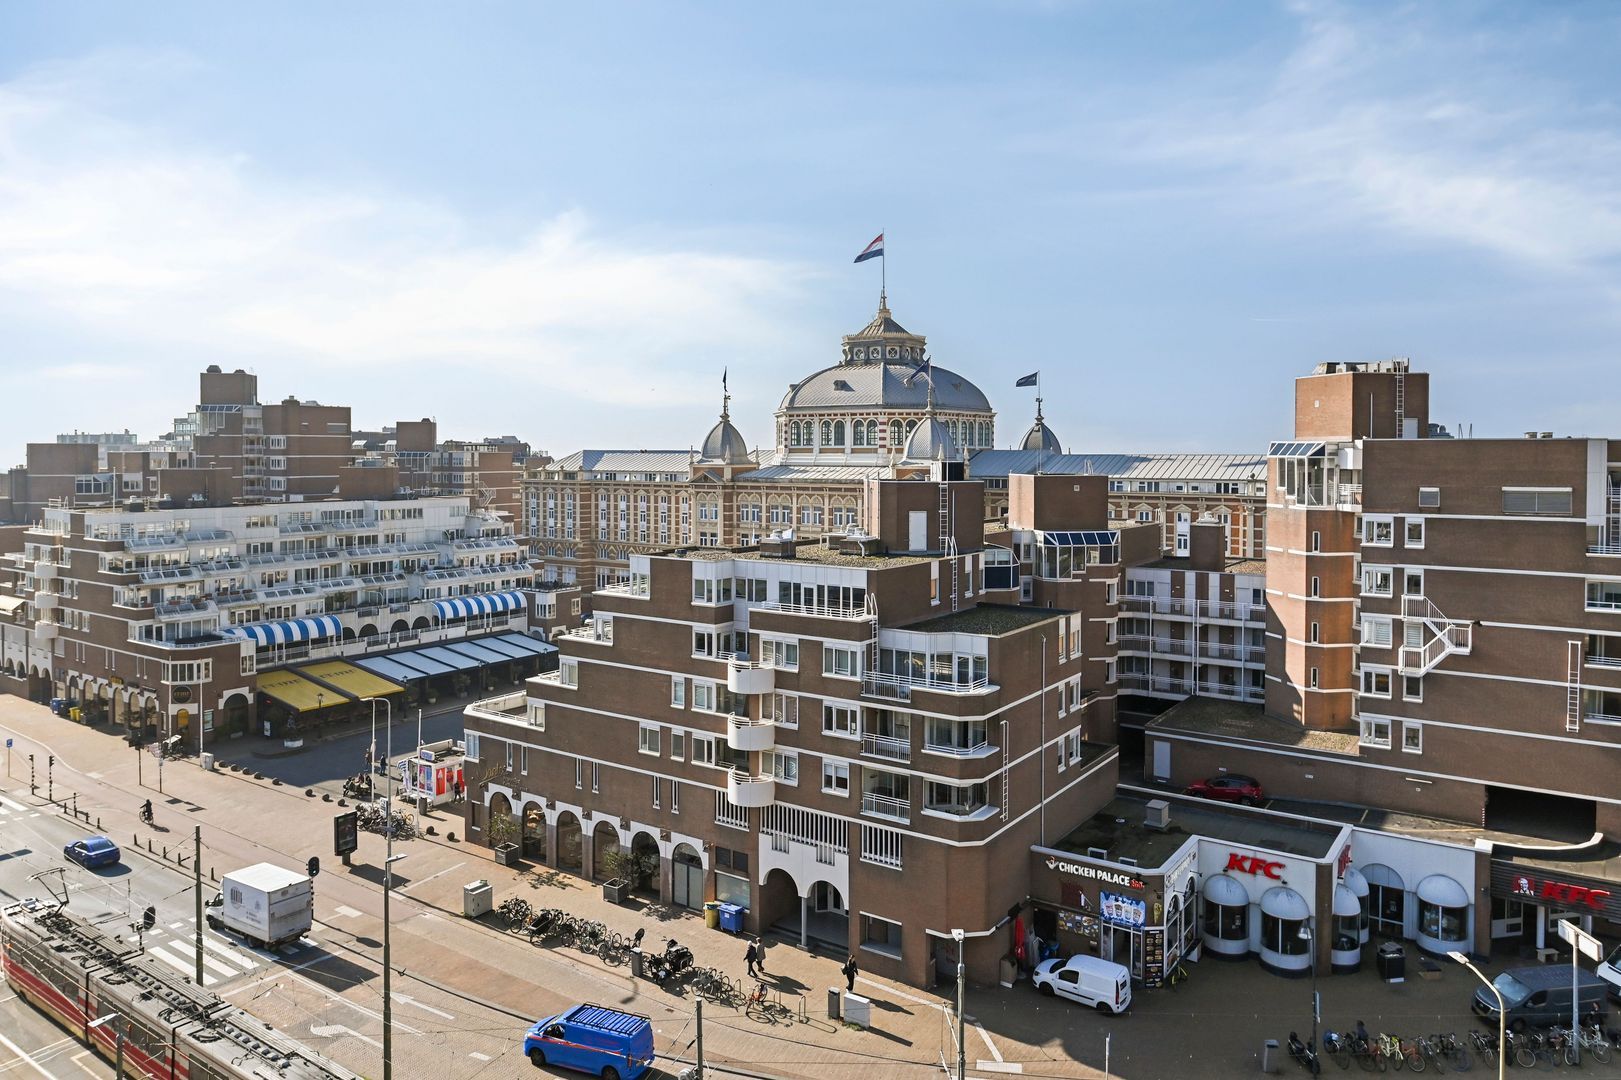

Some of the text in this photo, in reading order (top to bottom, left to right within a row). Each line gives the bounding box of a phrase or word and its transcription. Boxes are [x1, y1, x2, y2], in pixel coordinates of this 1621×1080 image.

[1059, 862, 1096, 879] CHICKEN
[1097, 870, 1130, 886] PALACE
[1228, 853, 1285, 880] KFC
[1541, 880, 1610, 909] KFC
